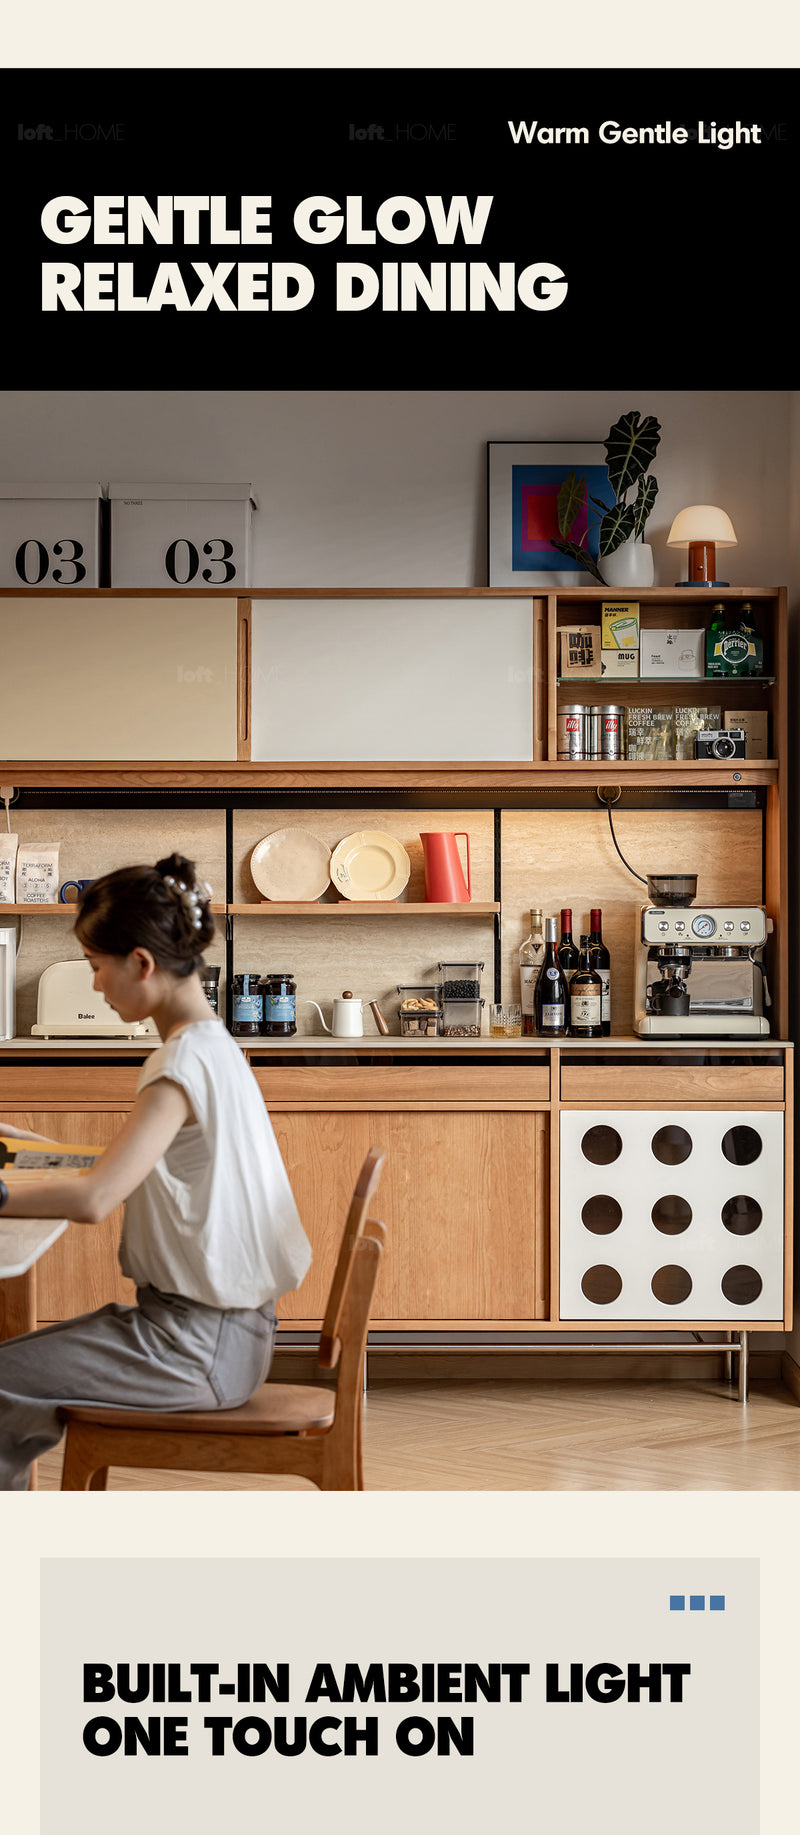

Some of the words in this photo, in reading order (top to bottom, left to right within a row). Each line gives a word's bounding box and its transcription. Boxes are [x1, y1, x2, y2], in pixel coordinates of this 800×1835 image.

[15, 539, 86, 584] 03
[165, 539, 236, 584] 03
[723, 639, 748, 656] Perrier
[566, 720, 579, 730] illy
[605, 719, 617, 730] illy
